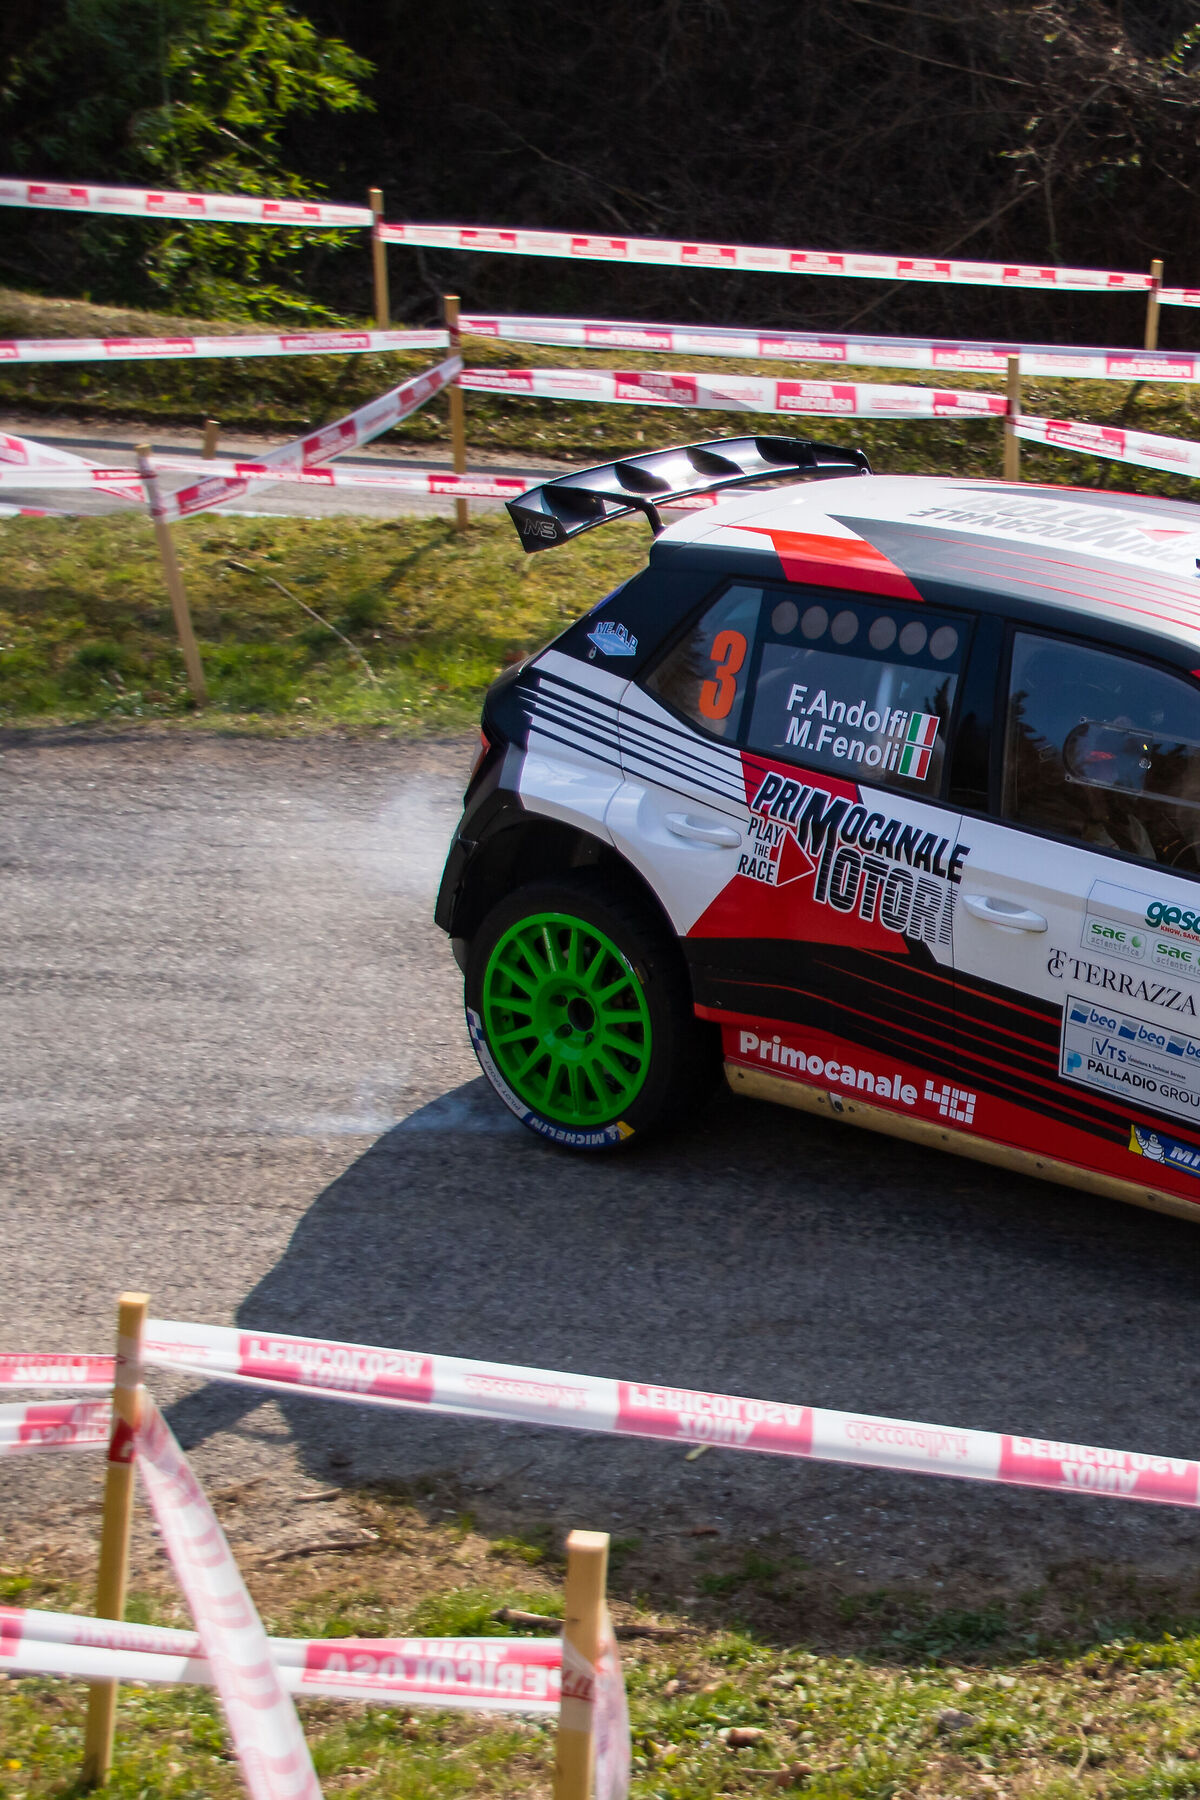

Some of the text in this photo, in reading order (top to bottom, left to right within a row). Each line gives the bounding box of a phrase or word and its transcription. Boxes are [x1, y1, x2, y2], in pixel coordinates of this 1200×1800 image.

[698, 629, 748, 720] 3
[786, 683, 908, 741] F.Andolfi
[785, 716, 901, 772] M.Fenoli
[747, 816, 786, 848] PLAY
[751, 771, 971, 885] PRIMOCANALE
[753, 841, 770, 859] THE
[737, 853, 778, 886] RACE
[1090, 922, 1126, 944] sae
[1160, 925, 1182, 937] KNOW,
[1156, 943, 1193, 963] sae
[1069, 958, 1197, 1017] TERRAZZA
[1089, 1008, 1117, 1029] bea
[1095, 1038, 1127, 1063] VTS
[1138, 1025, 1166, 1046] bea
[739, 1030, 919, 1106] Primocanale
[1087, 1059, 1157, 1092] PALLADIO
[529, 1116, 605, 1145] MICHELIN
